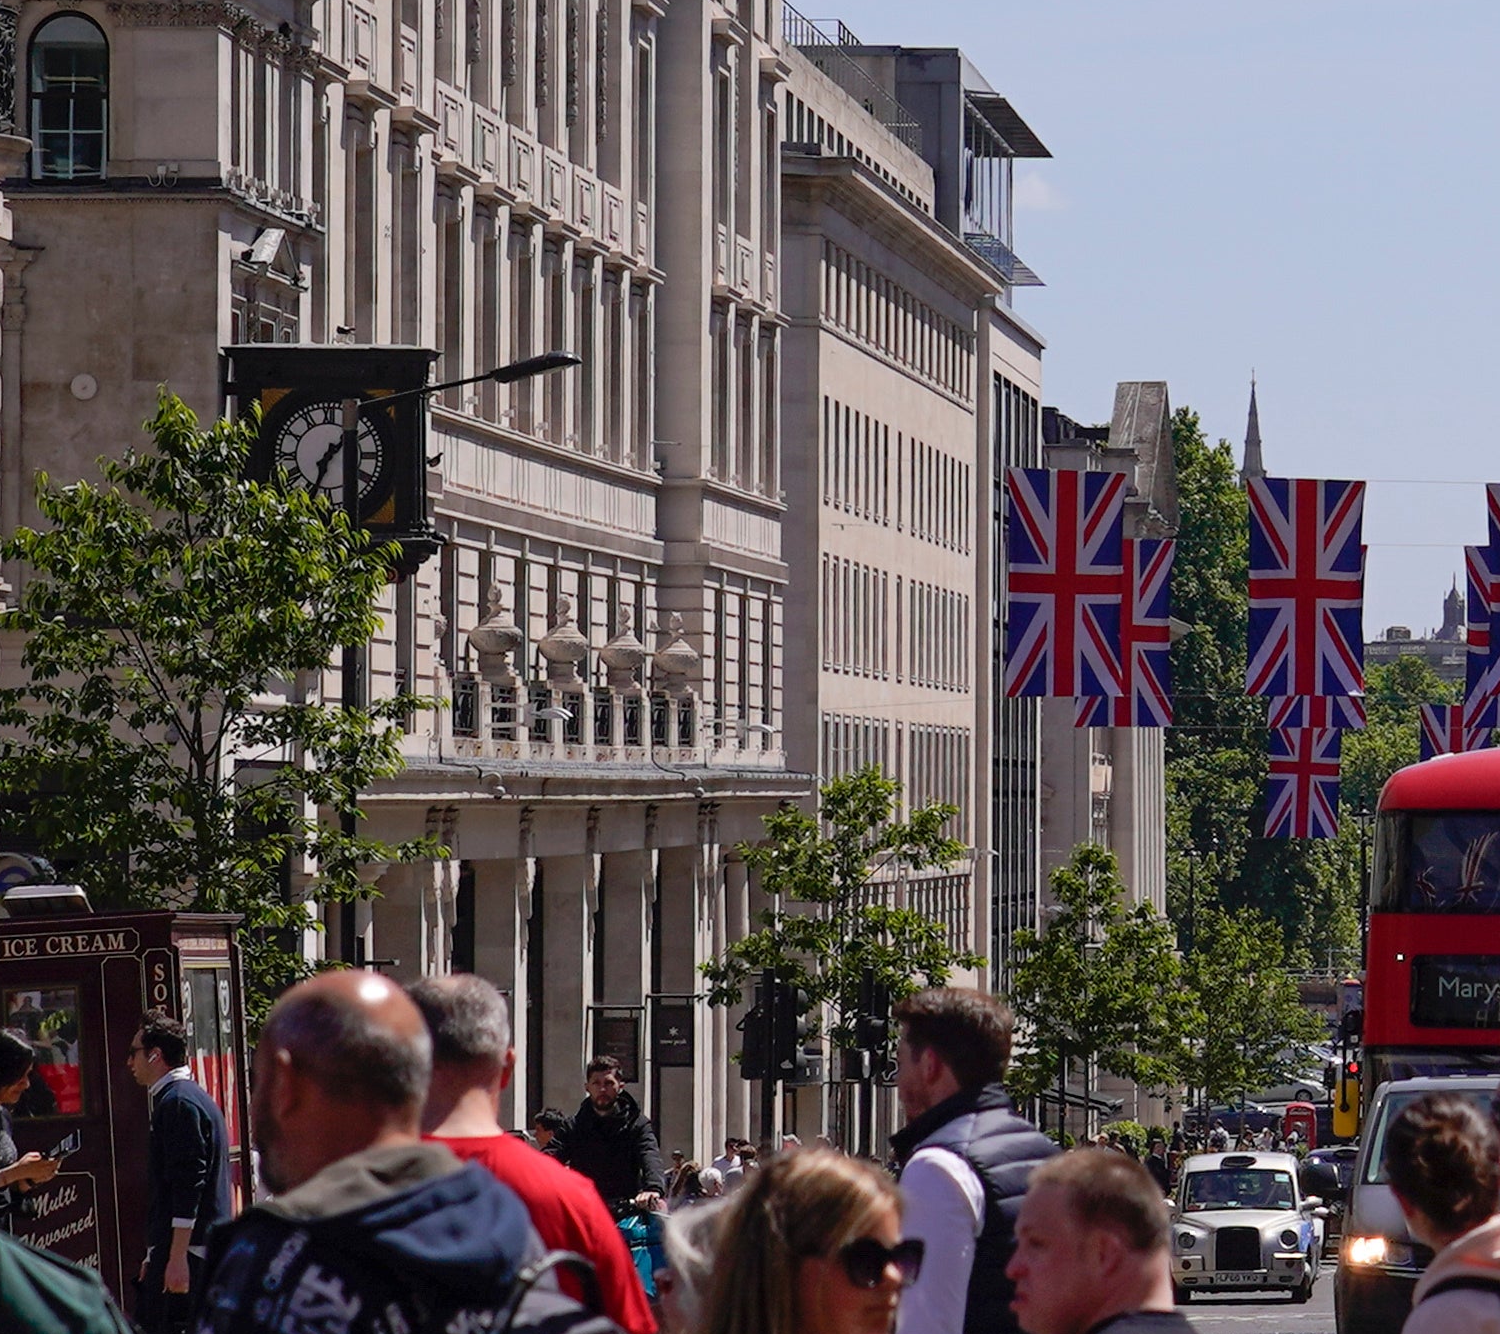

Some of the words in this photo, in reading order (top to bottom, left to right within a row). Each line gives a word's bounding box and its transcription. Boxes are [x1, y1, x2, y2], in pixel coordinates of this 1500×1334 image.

[2, 936, 38, 957] ICE
[45, 932, 127, 955] CREAM
[32, 1183, 78, 1221] Multi
